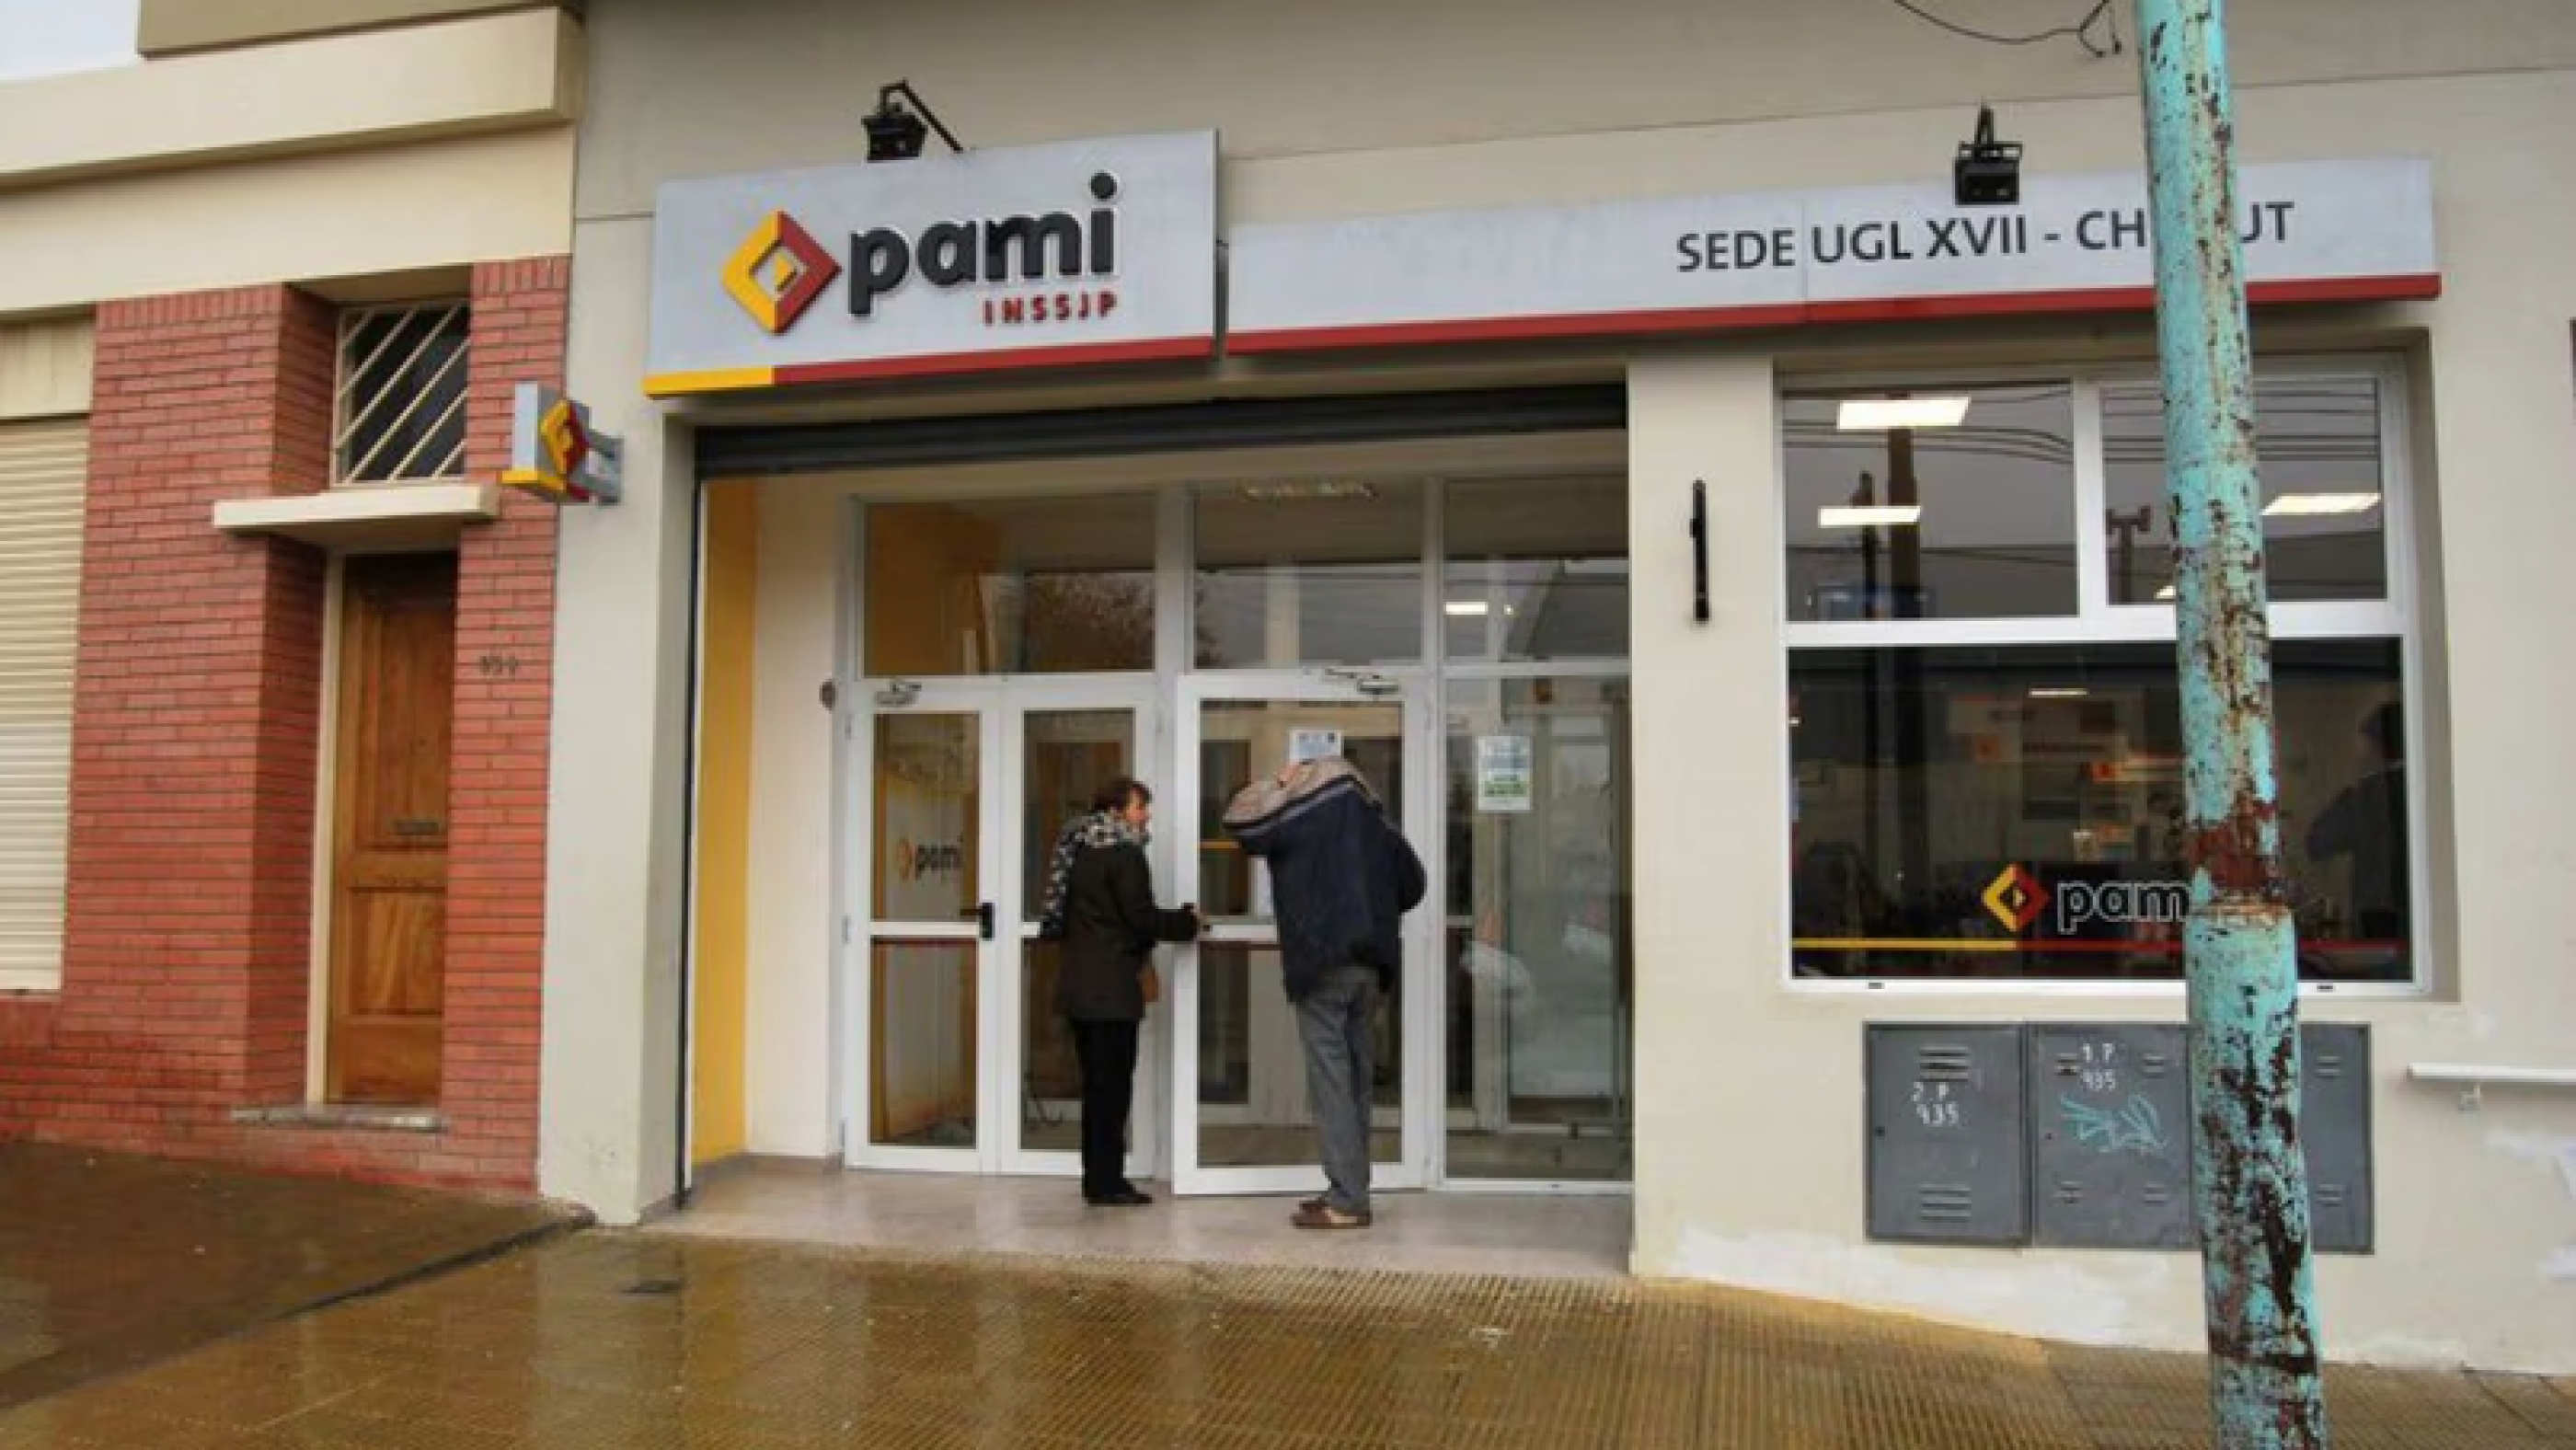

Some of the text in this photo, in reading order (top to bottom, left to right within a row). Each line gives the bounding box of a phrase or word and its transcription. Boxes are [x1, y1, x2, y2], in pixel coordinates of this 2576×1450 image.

[847, 170, 1117, 317] pami
[1677, 229, 1796, 272] SEDE
[1812, 220, 1912, 264] UGL
[1926, 214, 2027, 257] XVII
[2076, 201, 2296, 251] CHUT
[983, 291, 1118, 325] INSSJP
[2056, 881, 2191, 936] pam
